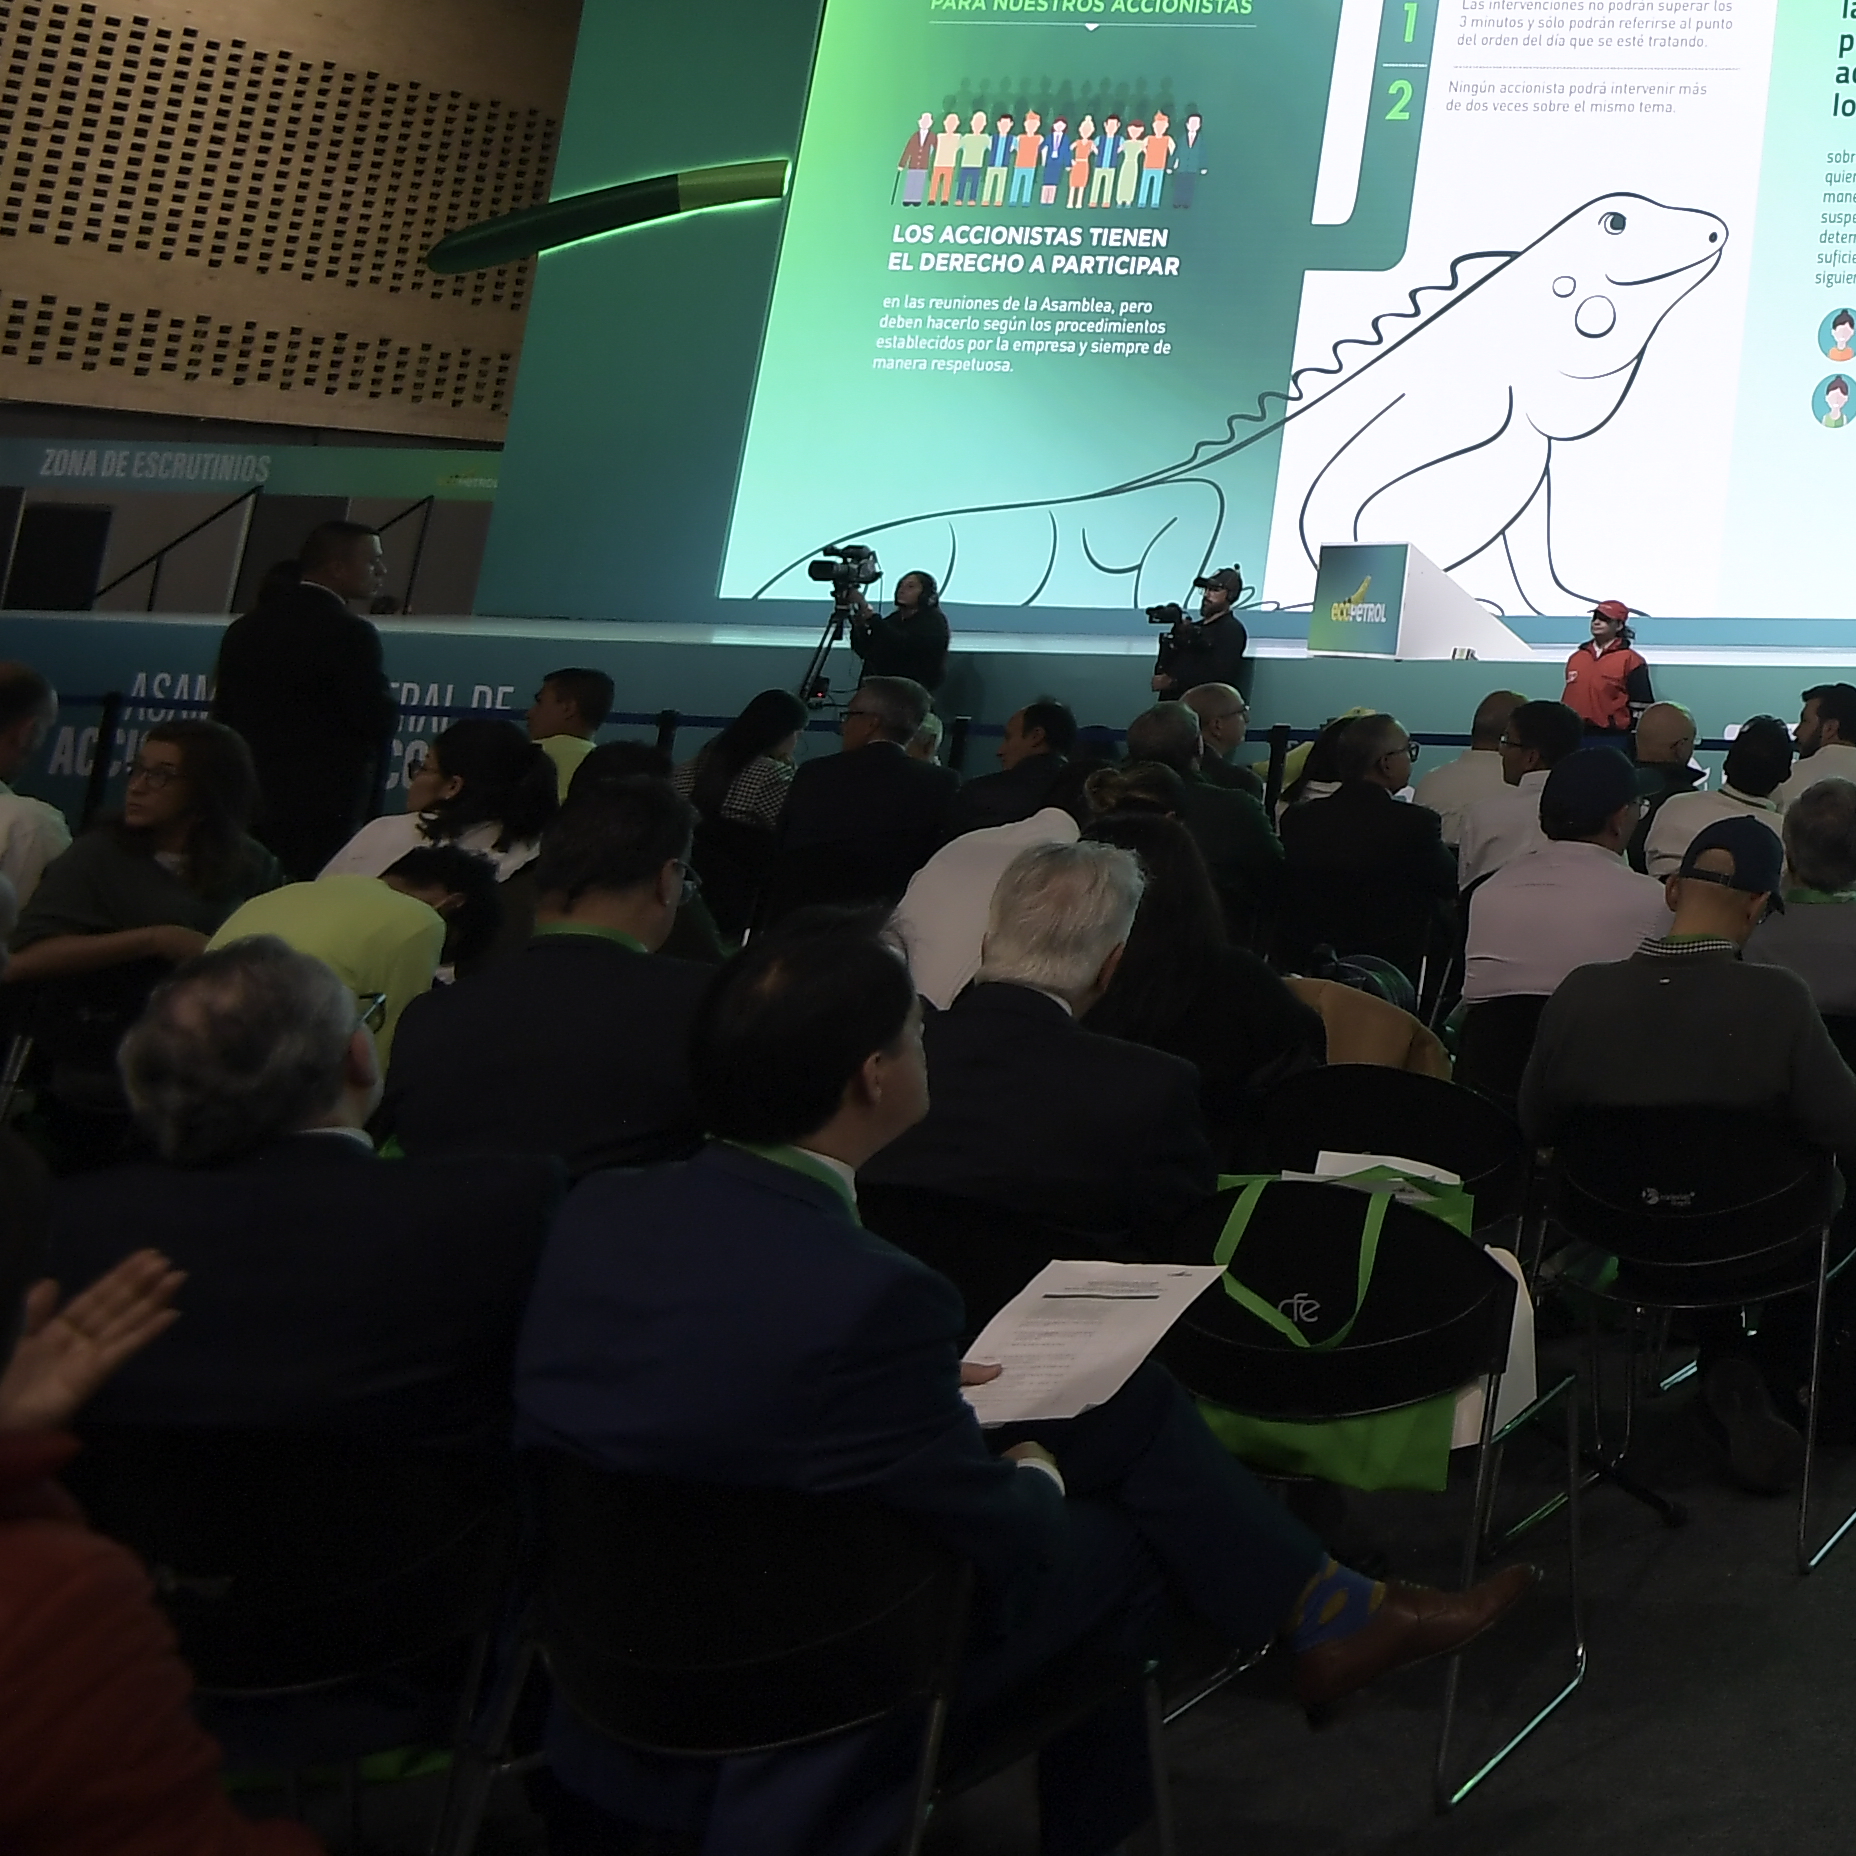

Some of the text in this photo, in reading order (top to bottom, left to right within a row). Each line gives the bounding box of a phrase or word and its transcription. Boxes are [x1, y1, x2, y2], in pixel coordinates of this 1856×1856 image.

[1489, 0, 1584, 11] intervenciones
[1588, 2, 1604, 11] no
[1658, 2, 1710, 14] superar
[1714, 0, 1732, 12] los
[1403, 3, 1417, 43] 1
[1385, 79, 1412, 120] 2
[893, 225, 1168, 247] LOS ACCIONISTAS TIENEN
[888, 252, 1180, 275] EL DERECHO A PARTICIPAR
[883, 294, 1152, 316] en las reuniones de la Asamblea, pero
[880, 314, 1166, 335] deben hacerlo según los procedimientos
[876, 335, 1171, 357] establecidos por la empresa y siempre de
[873, 358, 1013, 374] manera respetuosa.
[40, 448, 272, 483] ZONA DE ESCRUTINIOS
